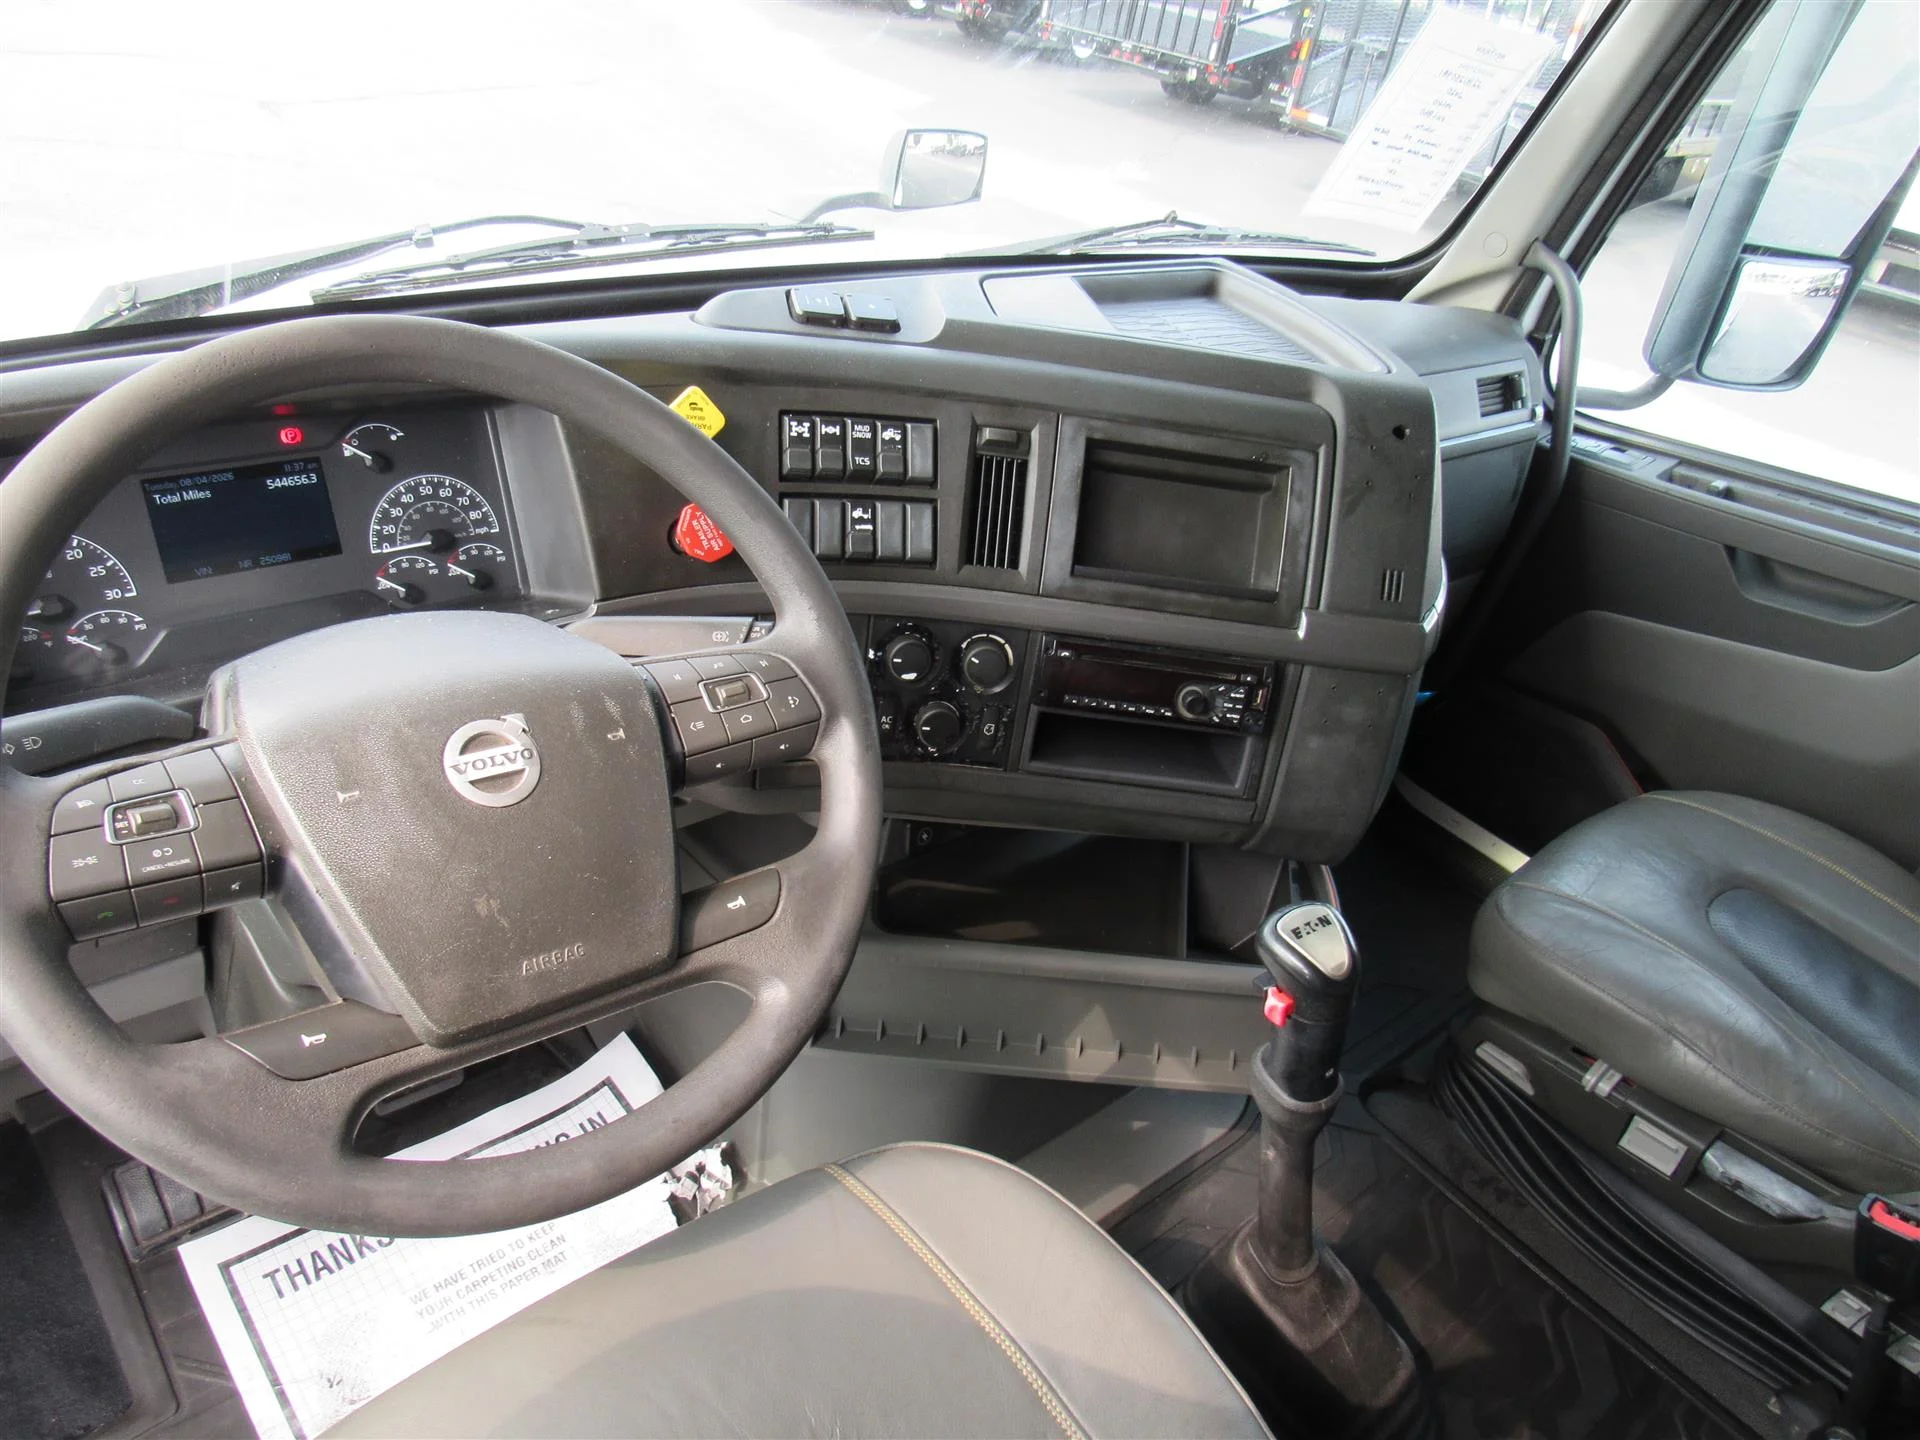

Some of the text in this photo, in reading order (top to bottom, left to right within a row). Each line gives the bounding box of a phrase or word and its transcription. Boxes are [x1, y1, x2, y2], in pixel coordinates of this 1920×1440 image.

[854, 424, 870, 432] MUD
[852, 431, 872, 439] SNOW
[854, 456, 870, 466] TCS
[266, 473, 318, 490] 544656.3
[419, 485, 433, 496] 50
[439, 487, 453, 498] 60
[152, 489, 212, 505] Total Miles
[400, 493, 414, 504] 40
[456, 496, 470, 507] 70
[389, 507, 403, 518] 30
[469, 510, 482, 520] 80
[382, 524, 396, 535] 20
[475, 526, 490, 535] mph
[65, 548, 83, 560] 20
[89, 565, 107, 577] 25
[104, 588, 121, 600] 30
[880, 715, 893, 724] AC
[448, 748, 534, 775] VOLVO
[114, 821, 129, 829] SET
[522, 942, 586, 976] AIRBAG
[408, 1222, 556, 1306] WE HAVE TRIED TO KEEP
[415, 1233, 567, 1320] YOUR CARPETING CLEAN
[429, 1250, 568, 1331] WITH THIS PAPER MAT
